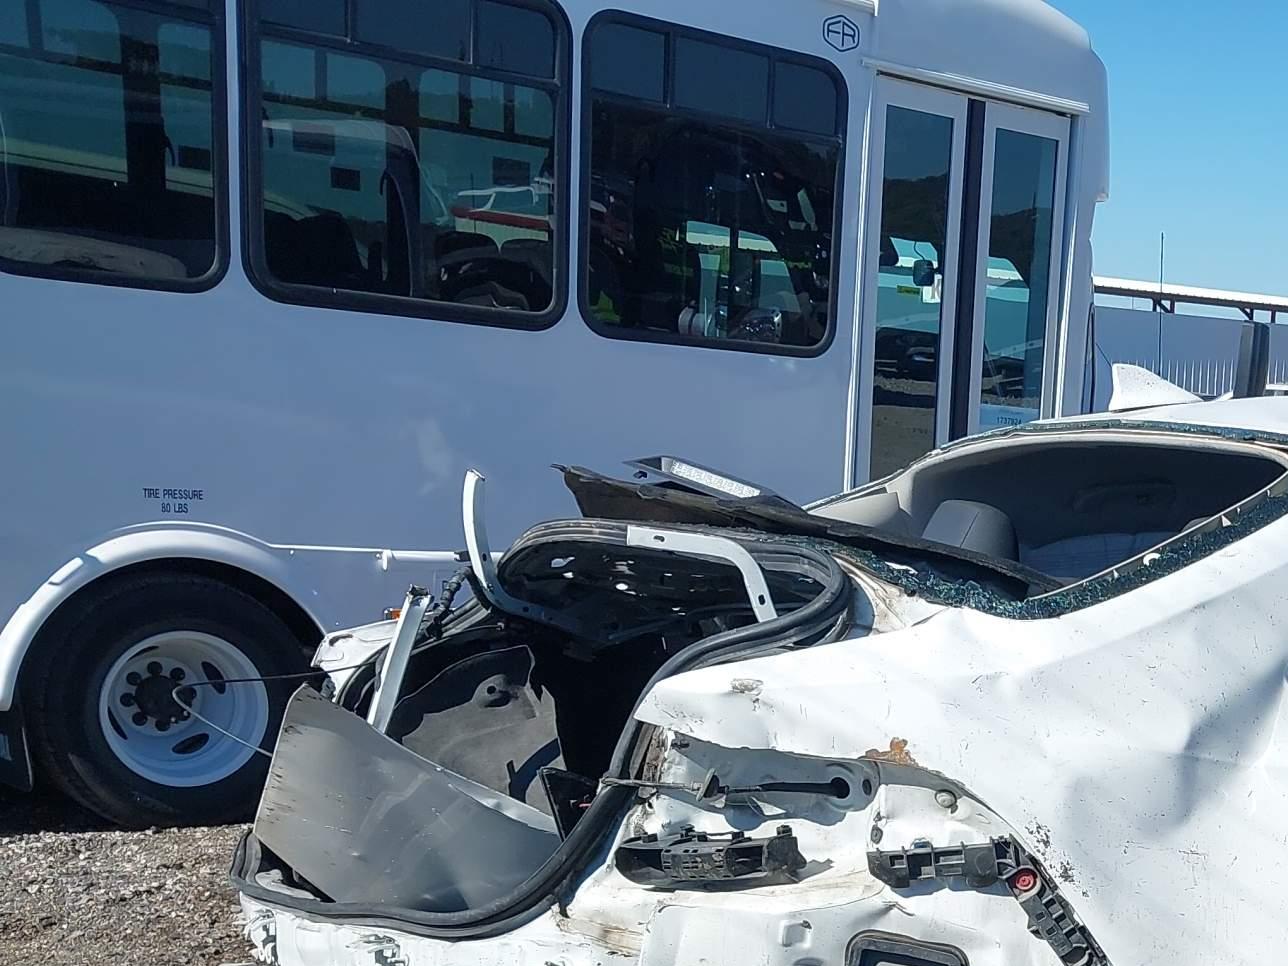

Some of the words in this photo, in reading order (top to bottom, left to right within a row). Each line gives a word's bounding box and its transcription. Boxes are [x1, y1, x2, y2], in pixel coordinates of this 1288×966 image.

[143, 487, 160, 498] TIRE
[162, 488, 204, 500] PRESSURE
[161, 502, 171, 513] 80
[173, 503, 188, 513] LBS
